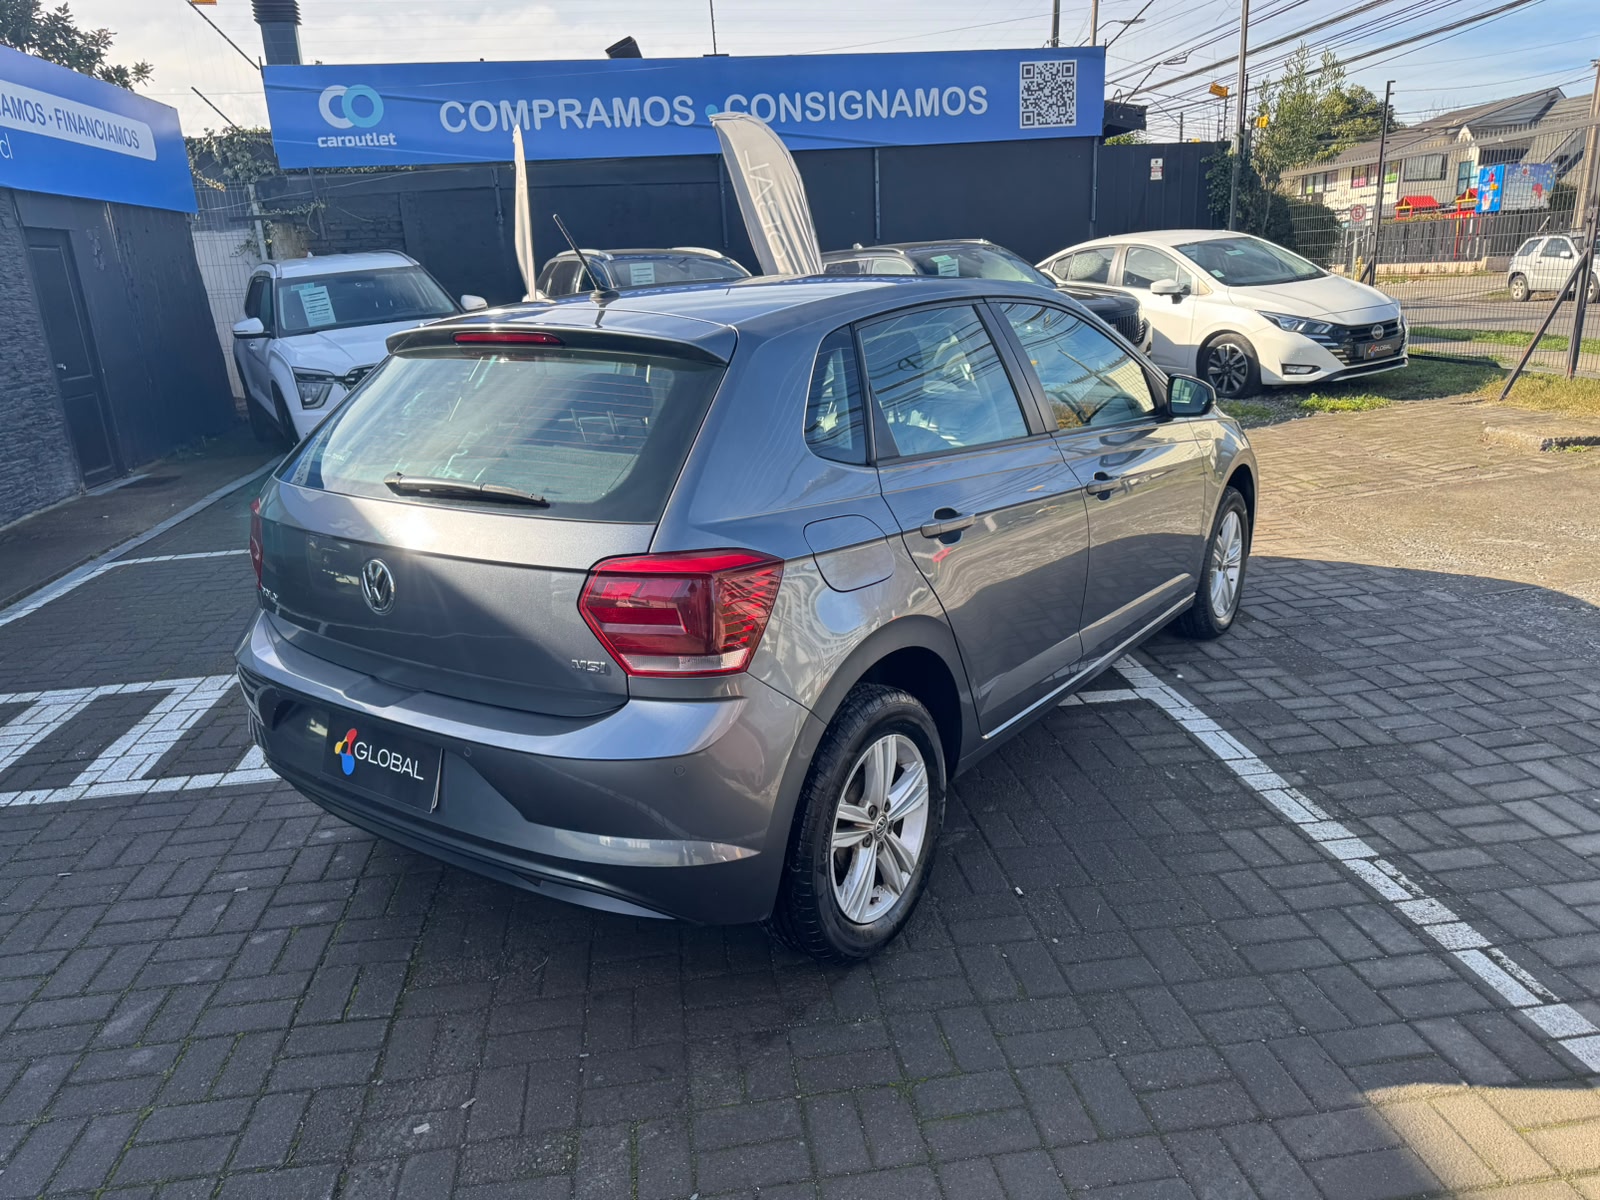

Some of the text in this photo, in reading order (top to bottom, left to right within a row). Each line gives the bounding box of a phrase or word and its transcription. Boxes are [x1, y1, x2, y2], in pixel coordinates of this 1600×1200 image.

[0, 93, 140, 150] AMOS FINANCIAMOS
[439, 86, 989, 133] COMPRAMOS CONSIGNAMOS
[317, 132, 398, 148] caroutlet
[354, 741, 424, 781] GLOBAL
